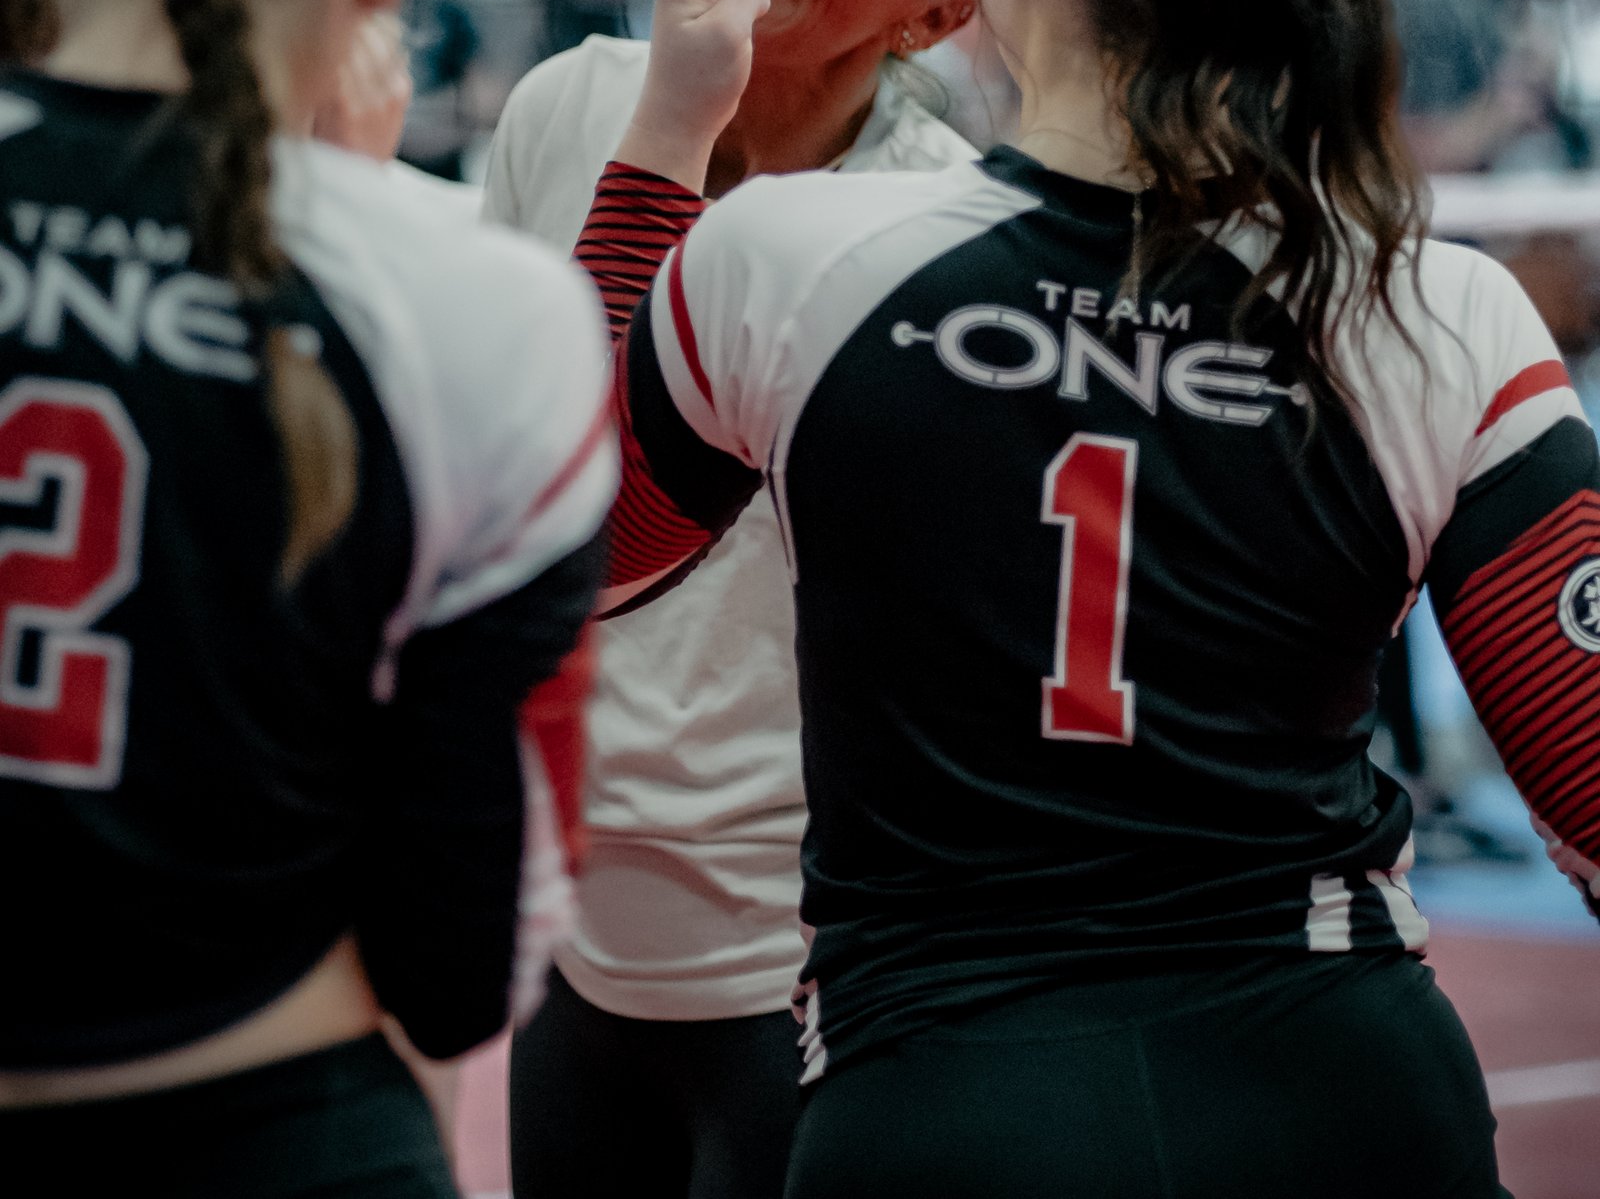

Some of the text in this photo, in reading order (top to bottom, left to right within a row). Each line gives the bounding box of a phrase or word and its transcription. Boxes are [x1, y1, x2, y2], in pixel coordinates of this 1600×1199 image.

[10, 201, 193, 263] TEAM
[0, 246, 259, 382] NE
[934, 302, 1273, 426] ONE
[1036, 280, 1192, 332] TEAM
[0, 376, 149, 789] 2
[1040, 432, 1139, 745] 1
